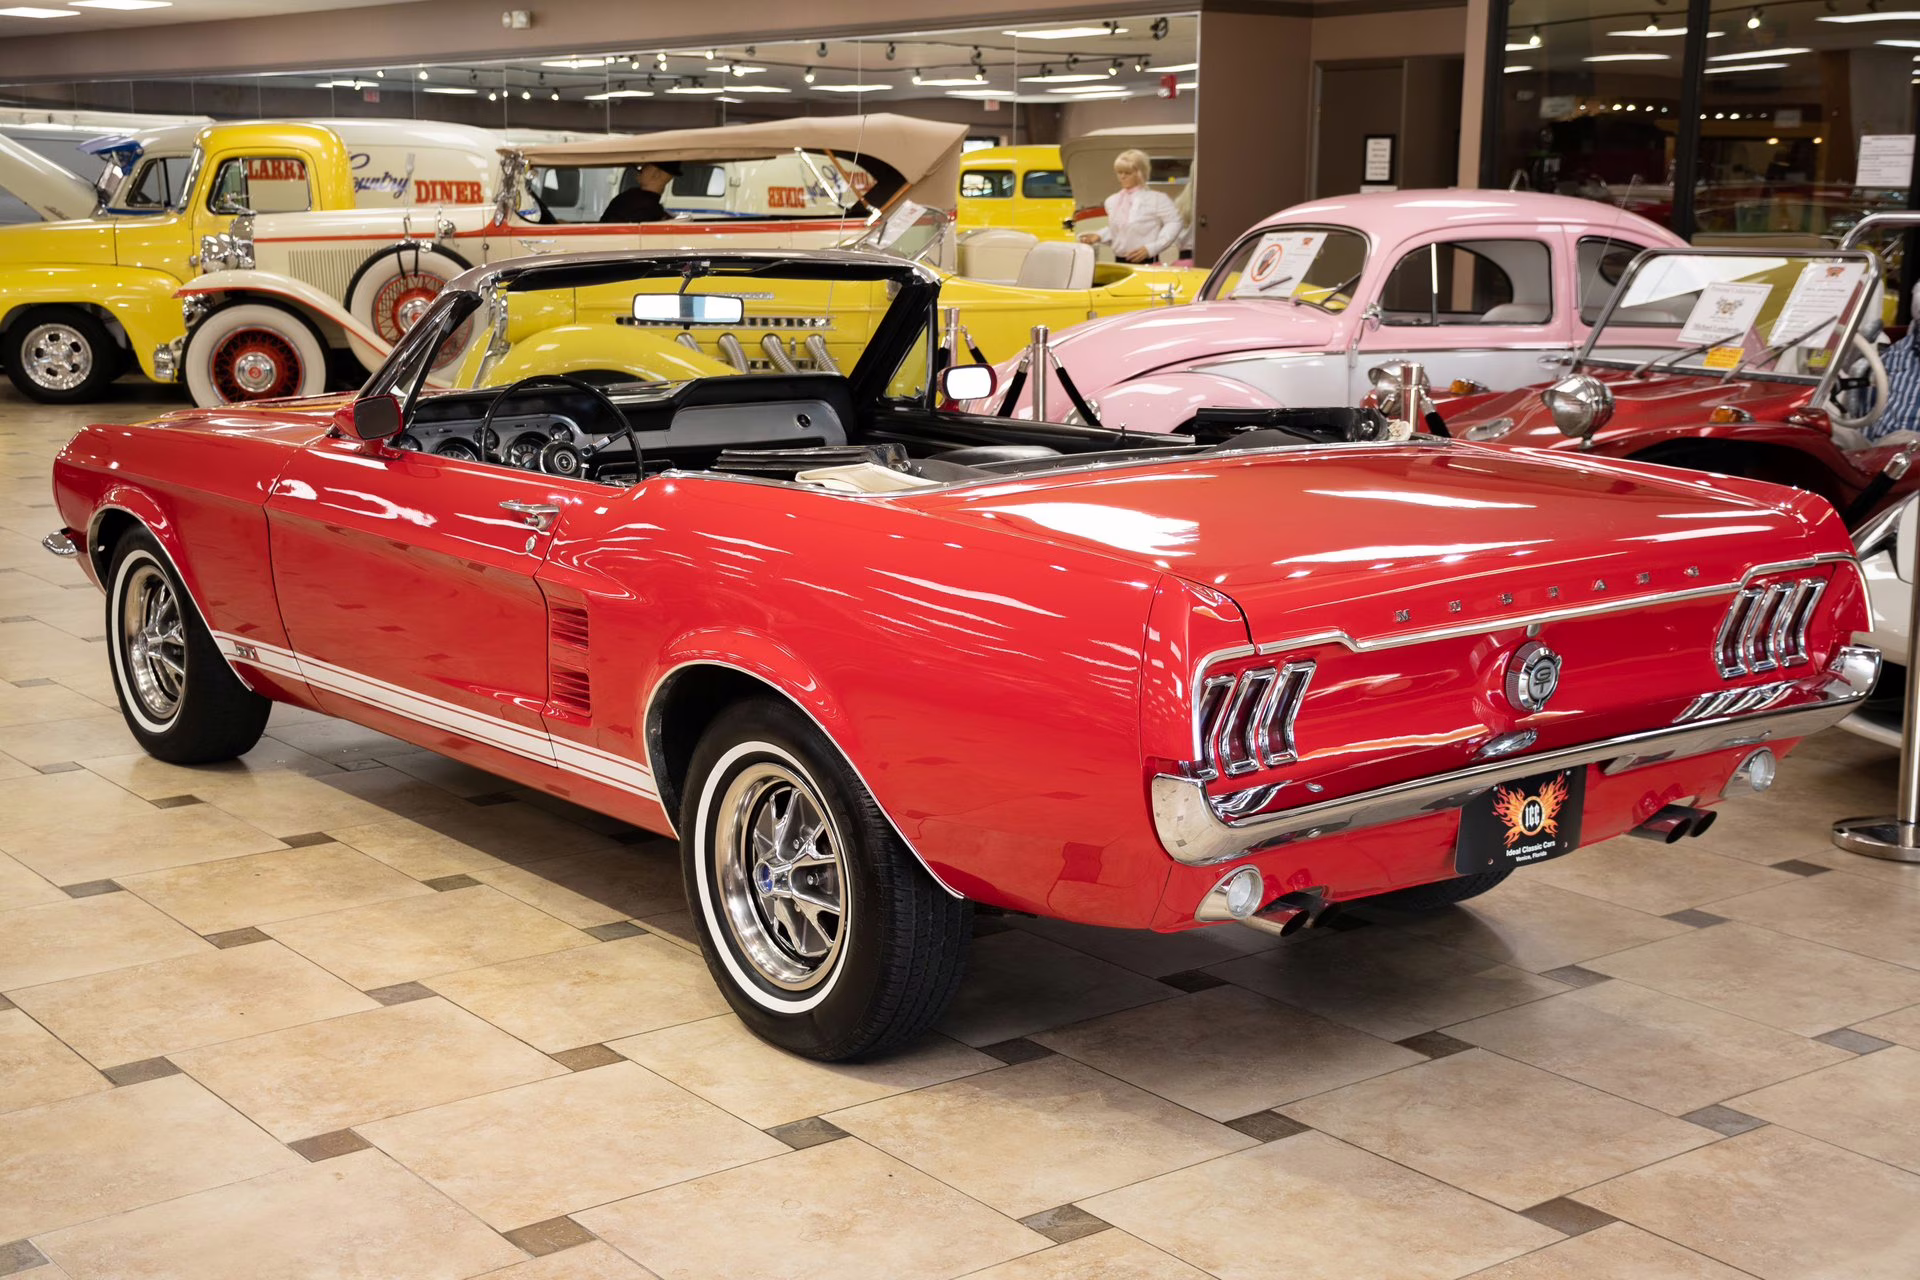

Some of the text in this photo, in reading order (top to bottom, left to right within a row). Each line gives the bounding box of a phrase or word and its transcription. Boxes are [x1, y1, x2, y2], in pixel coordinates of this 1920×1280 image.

[415, 180, 484, 204] DINER
[1395, 565, 1700, 623] MUSTANG
[1534, 667, 1551, 693] GT
[1506, 840, 1556, 856] Ideal Classic Cars
